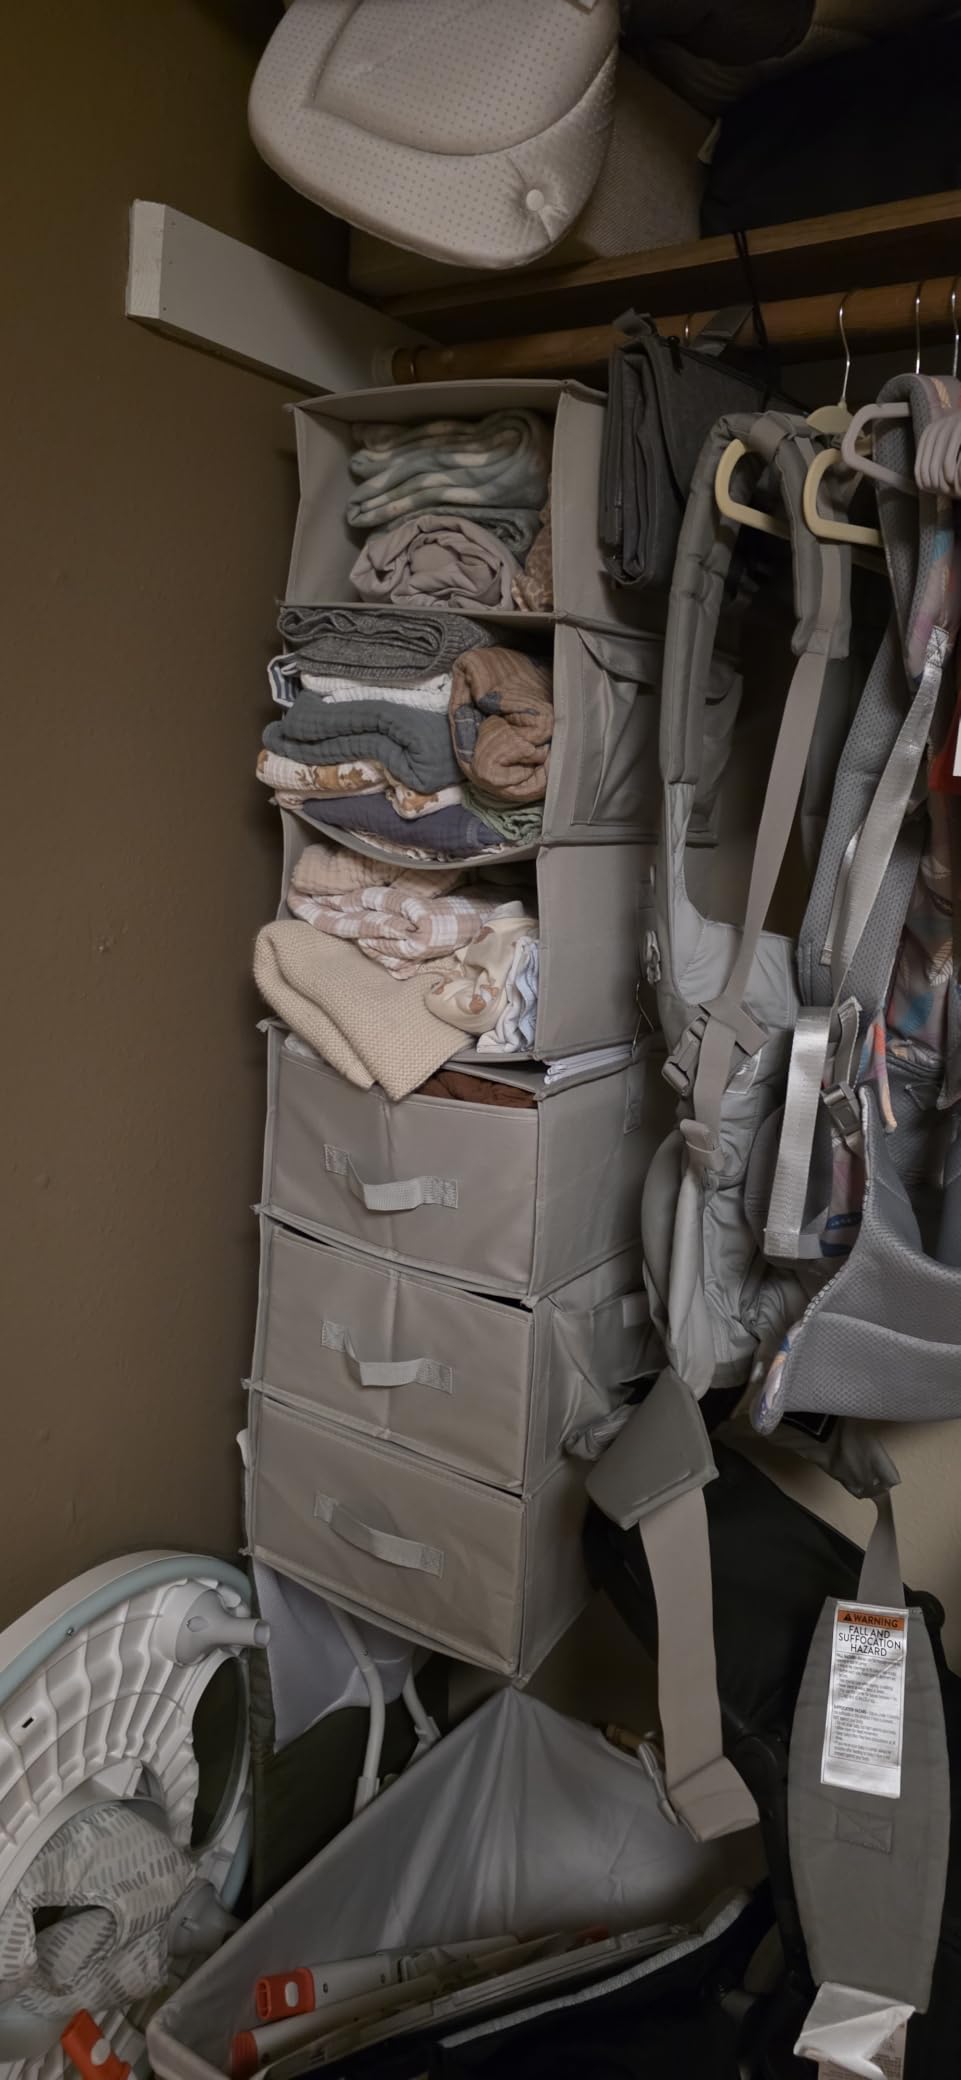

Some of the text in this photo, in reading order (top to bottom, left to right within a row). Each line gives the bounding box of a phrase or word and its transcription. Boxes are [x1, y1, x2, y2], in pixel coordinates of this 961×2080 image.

[854, 1614, 898, 1628] WARNING
[849, 1625, 890, 1639] FALL AND
[838, 1632, 901, 1650] SUFFOCATION
[850, 1644, 887, 1657] HAZARD
